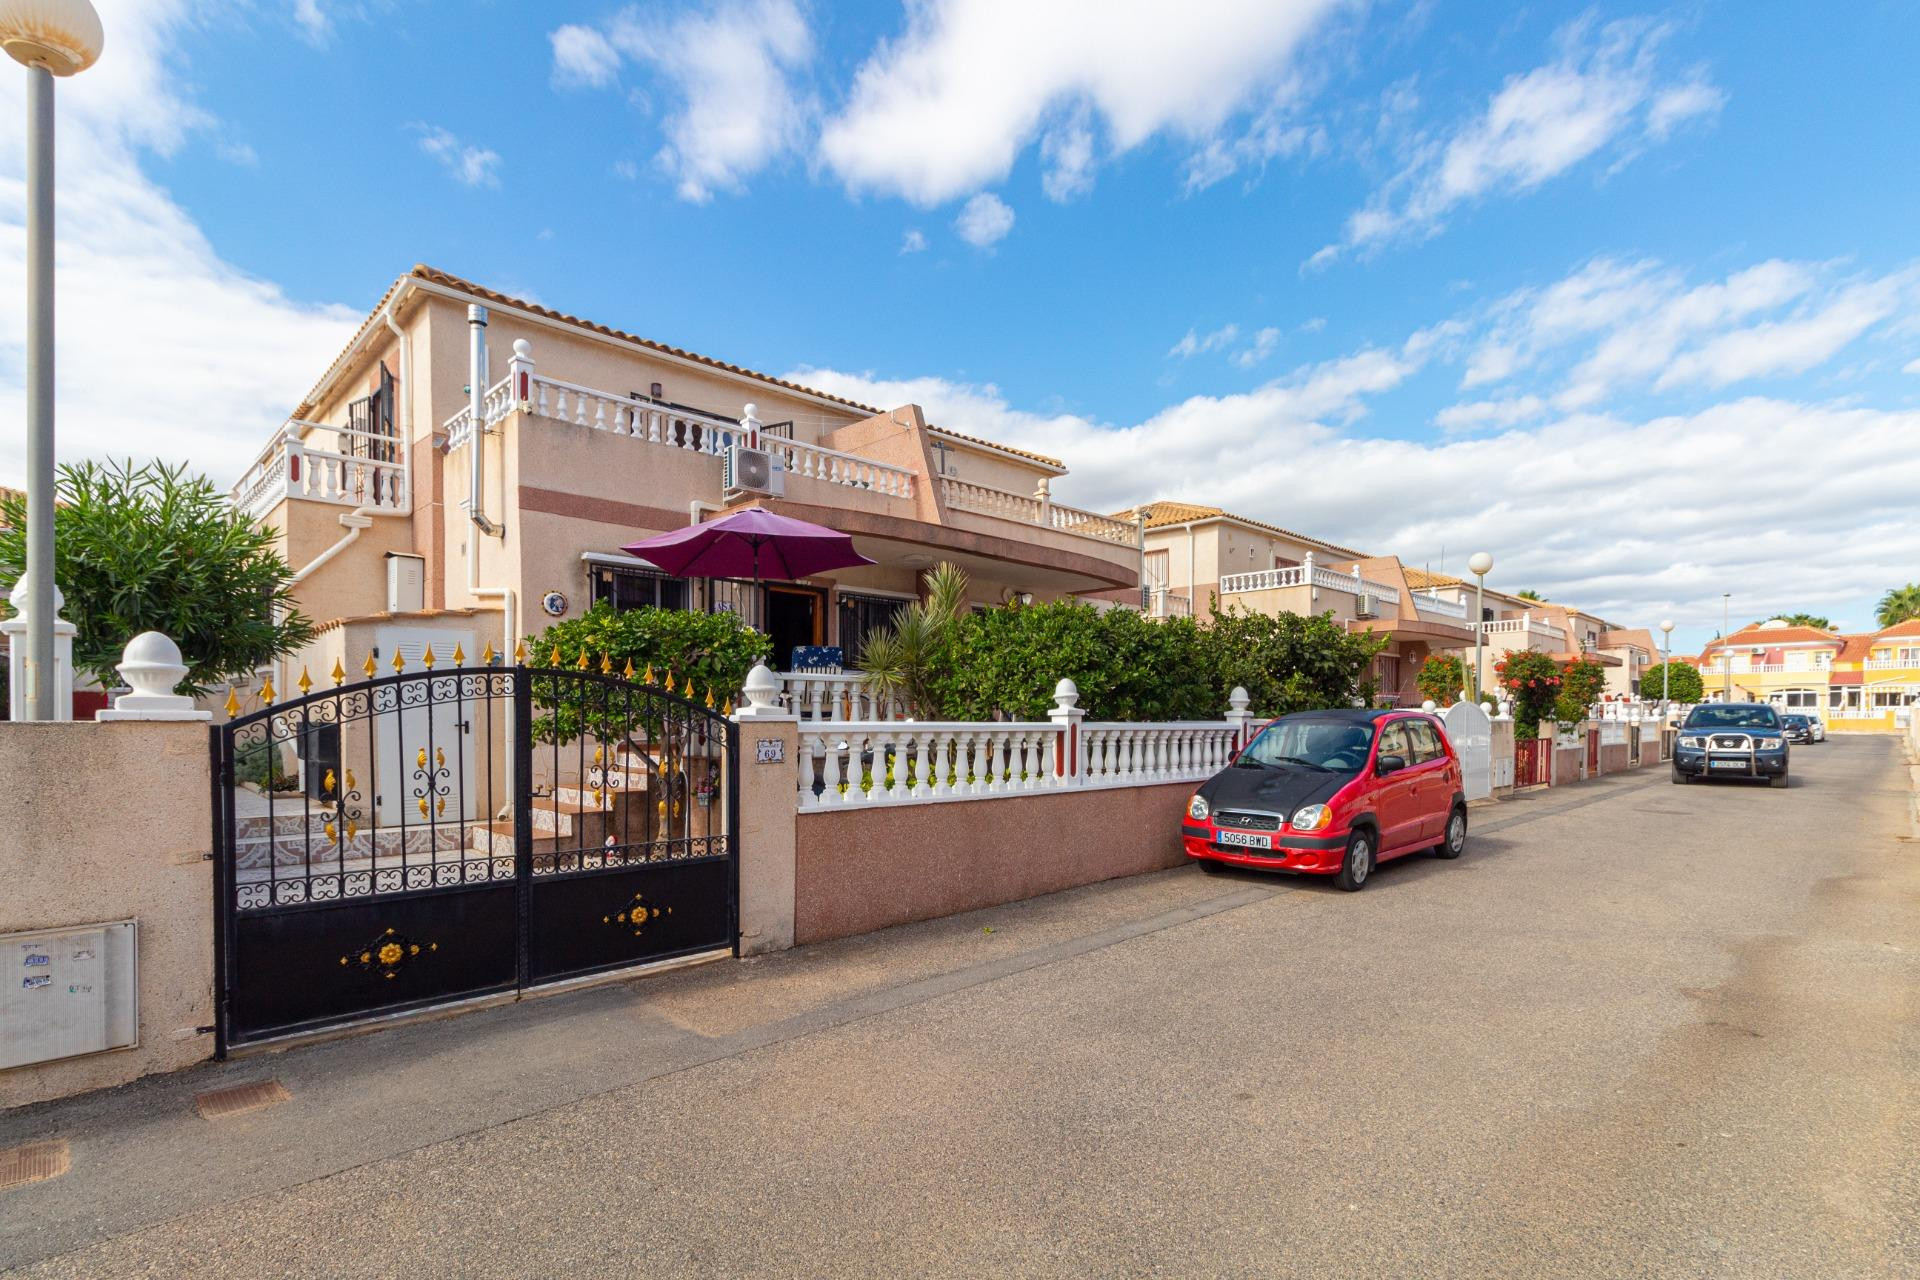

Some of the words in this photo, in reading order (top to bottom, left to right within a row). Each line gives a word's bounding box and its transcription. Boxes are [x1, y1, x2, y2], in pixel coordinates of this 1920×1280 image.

[764, 749, 776, 758] 69
[1224, 832, 1247, 845] 5056
[1249, 835, 1268, 847] BWD
